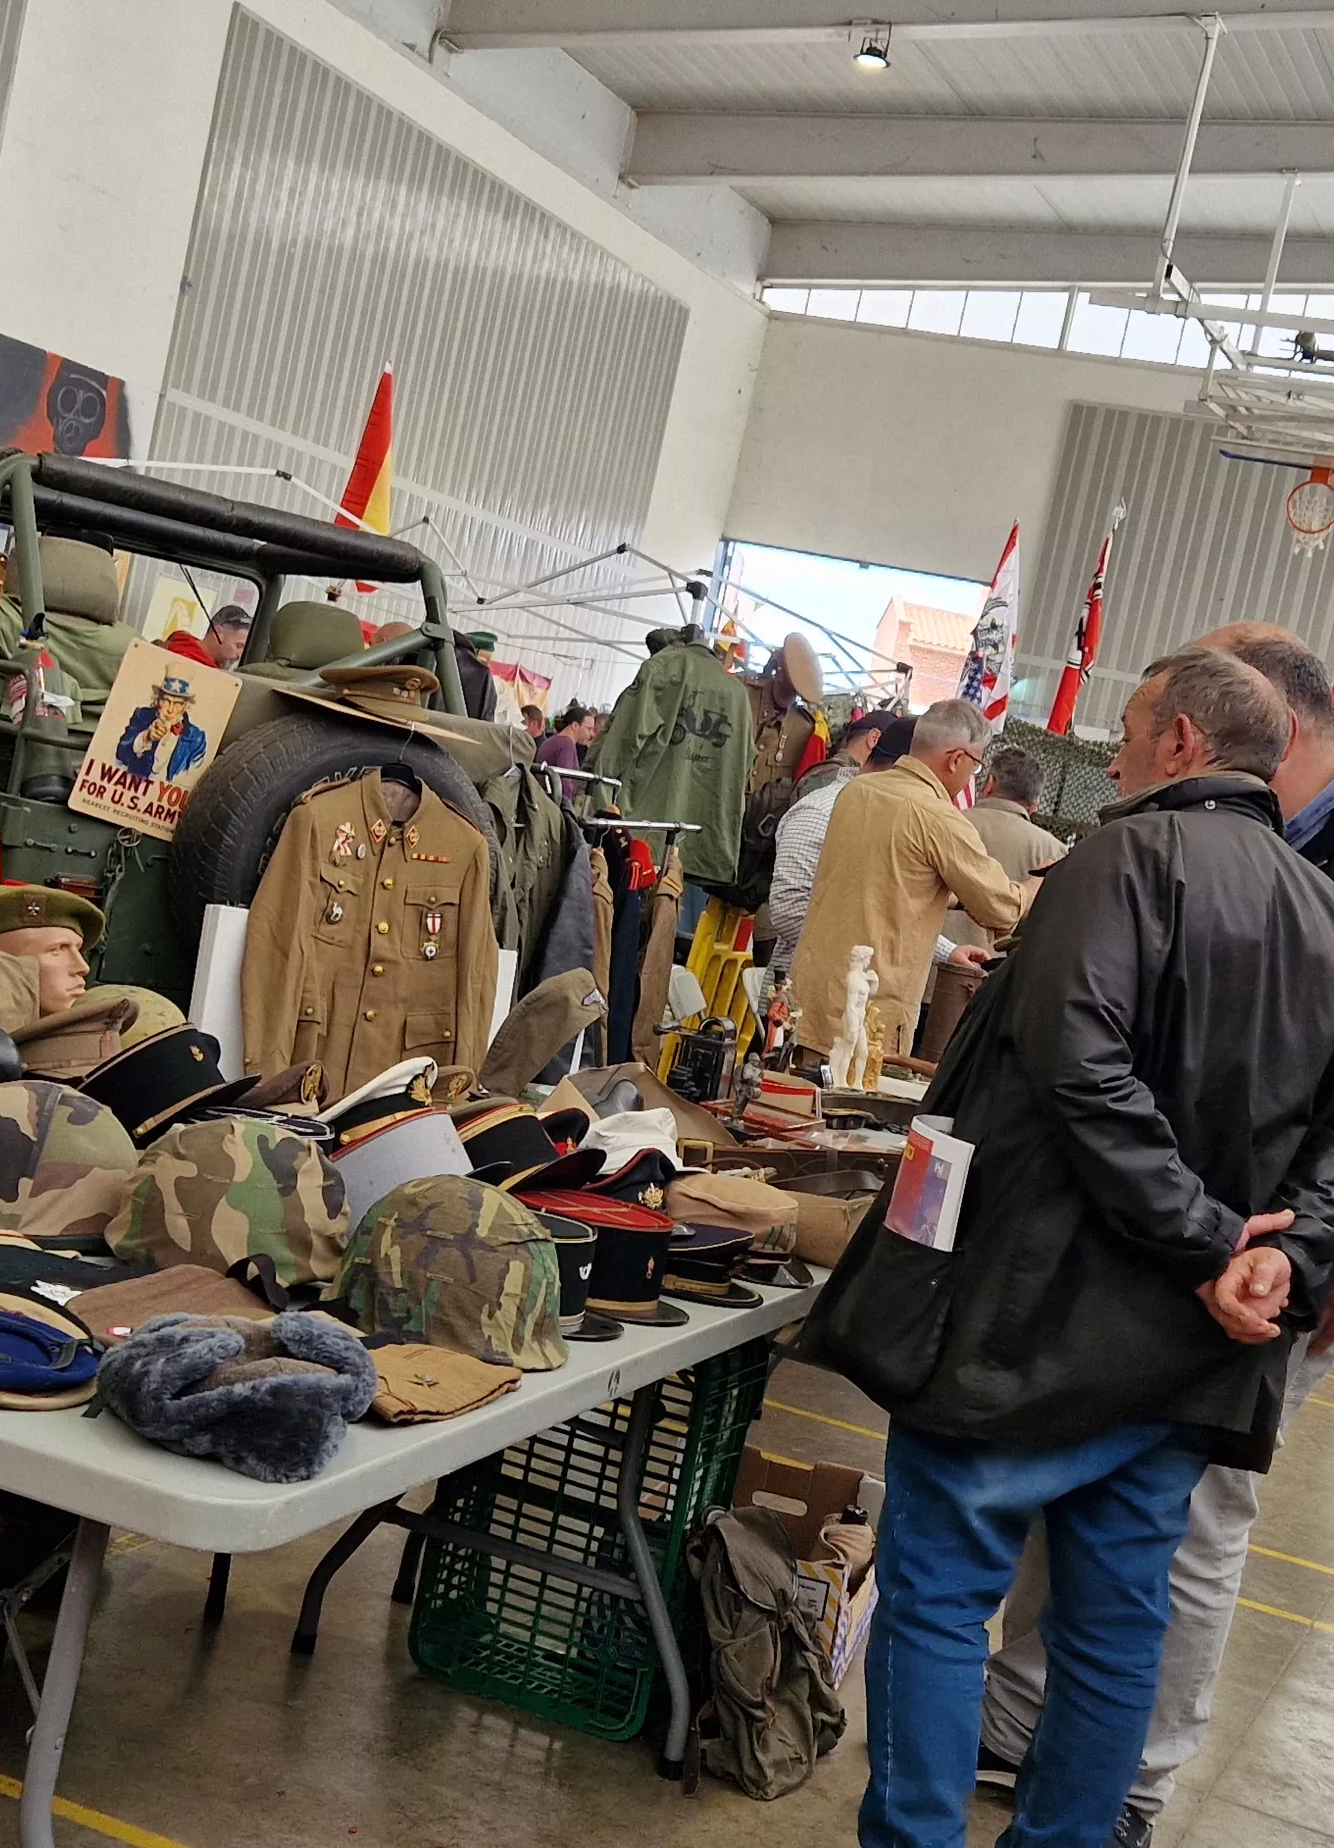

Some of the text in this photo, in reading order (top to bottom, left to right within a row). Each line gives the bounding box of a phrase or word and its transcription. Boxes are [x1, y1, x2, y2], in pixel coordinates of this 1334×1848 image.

[78, 778, 107, 800] FOR
[85, 758, 96, 777] I
[100, 762, 155, 797] WANT
